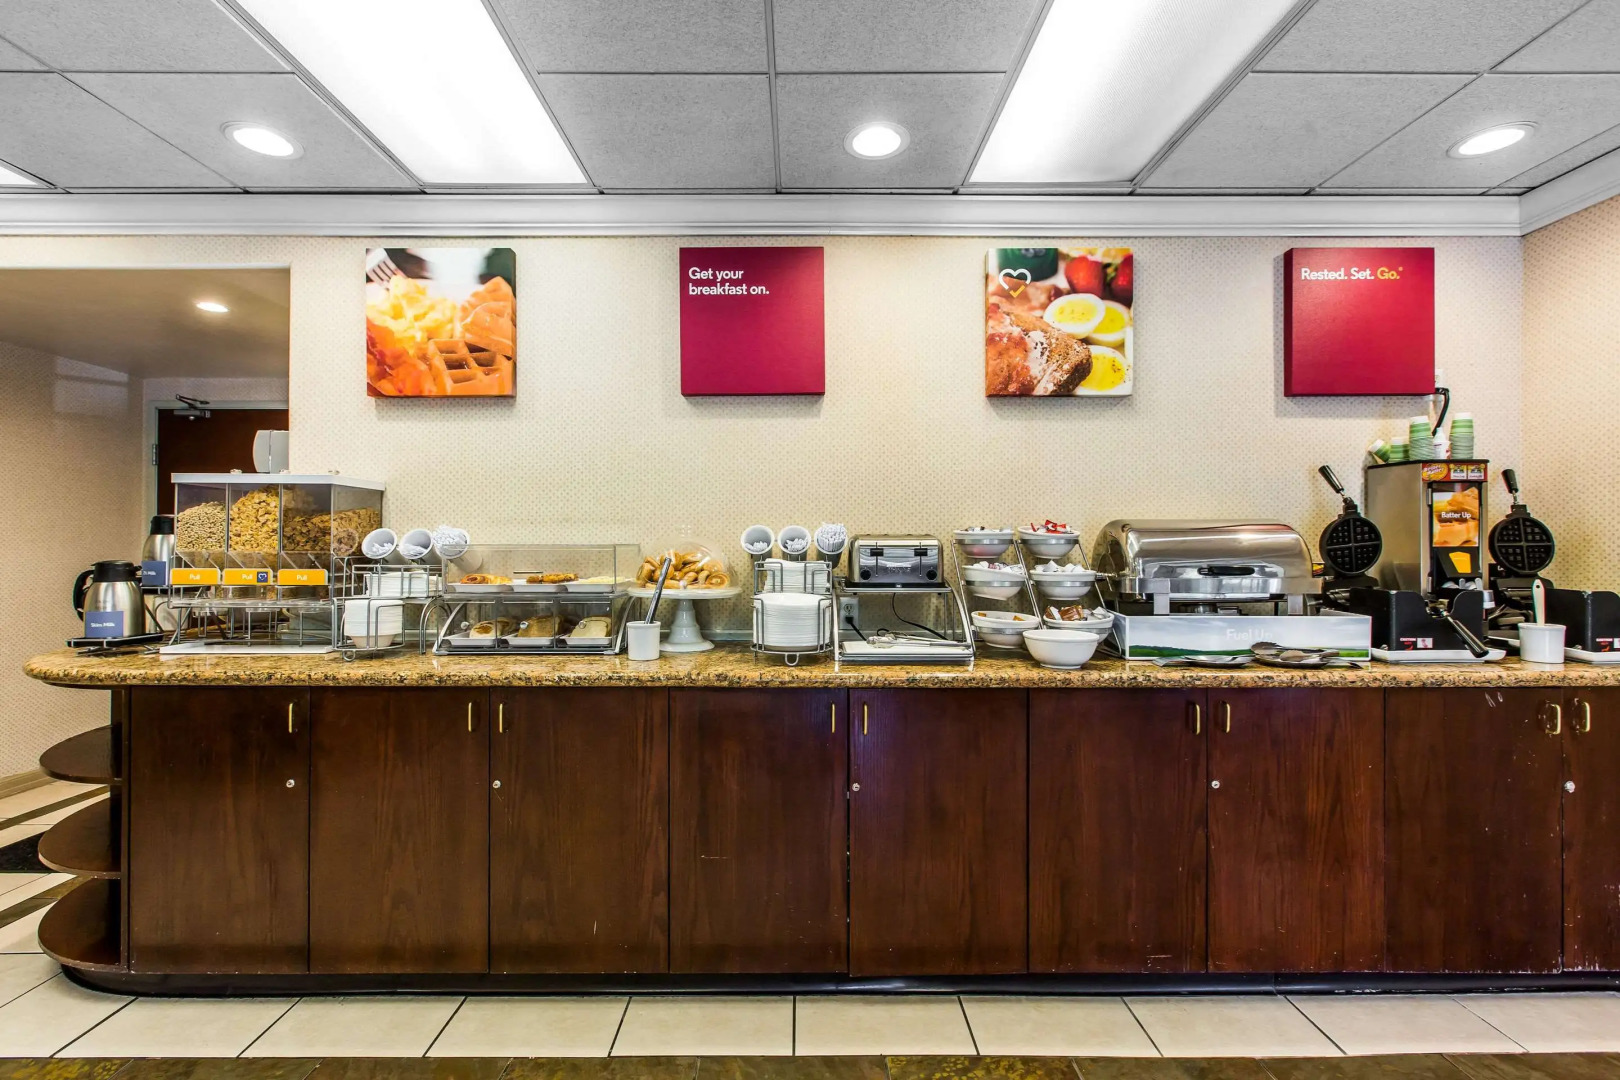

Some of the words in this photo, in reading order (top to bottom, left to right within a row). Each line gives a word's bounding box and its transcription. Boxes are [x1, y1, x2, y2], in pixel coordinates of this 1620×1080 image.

[688, 267, 713, 280] Get
[716, 270, 744, 282] your
[1301, 268, 1348, 280] Rested.
[1350, 268, 1375, 280] Set.
[688, 283, 748, 295] breakfast
[749, 285, 770, 295] on.
[1461, 511, 1472, 519] Up
[1226, 628, 1252, 641] Fuel
